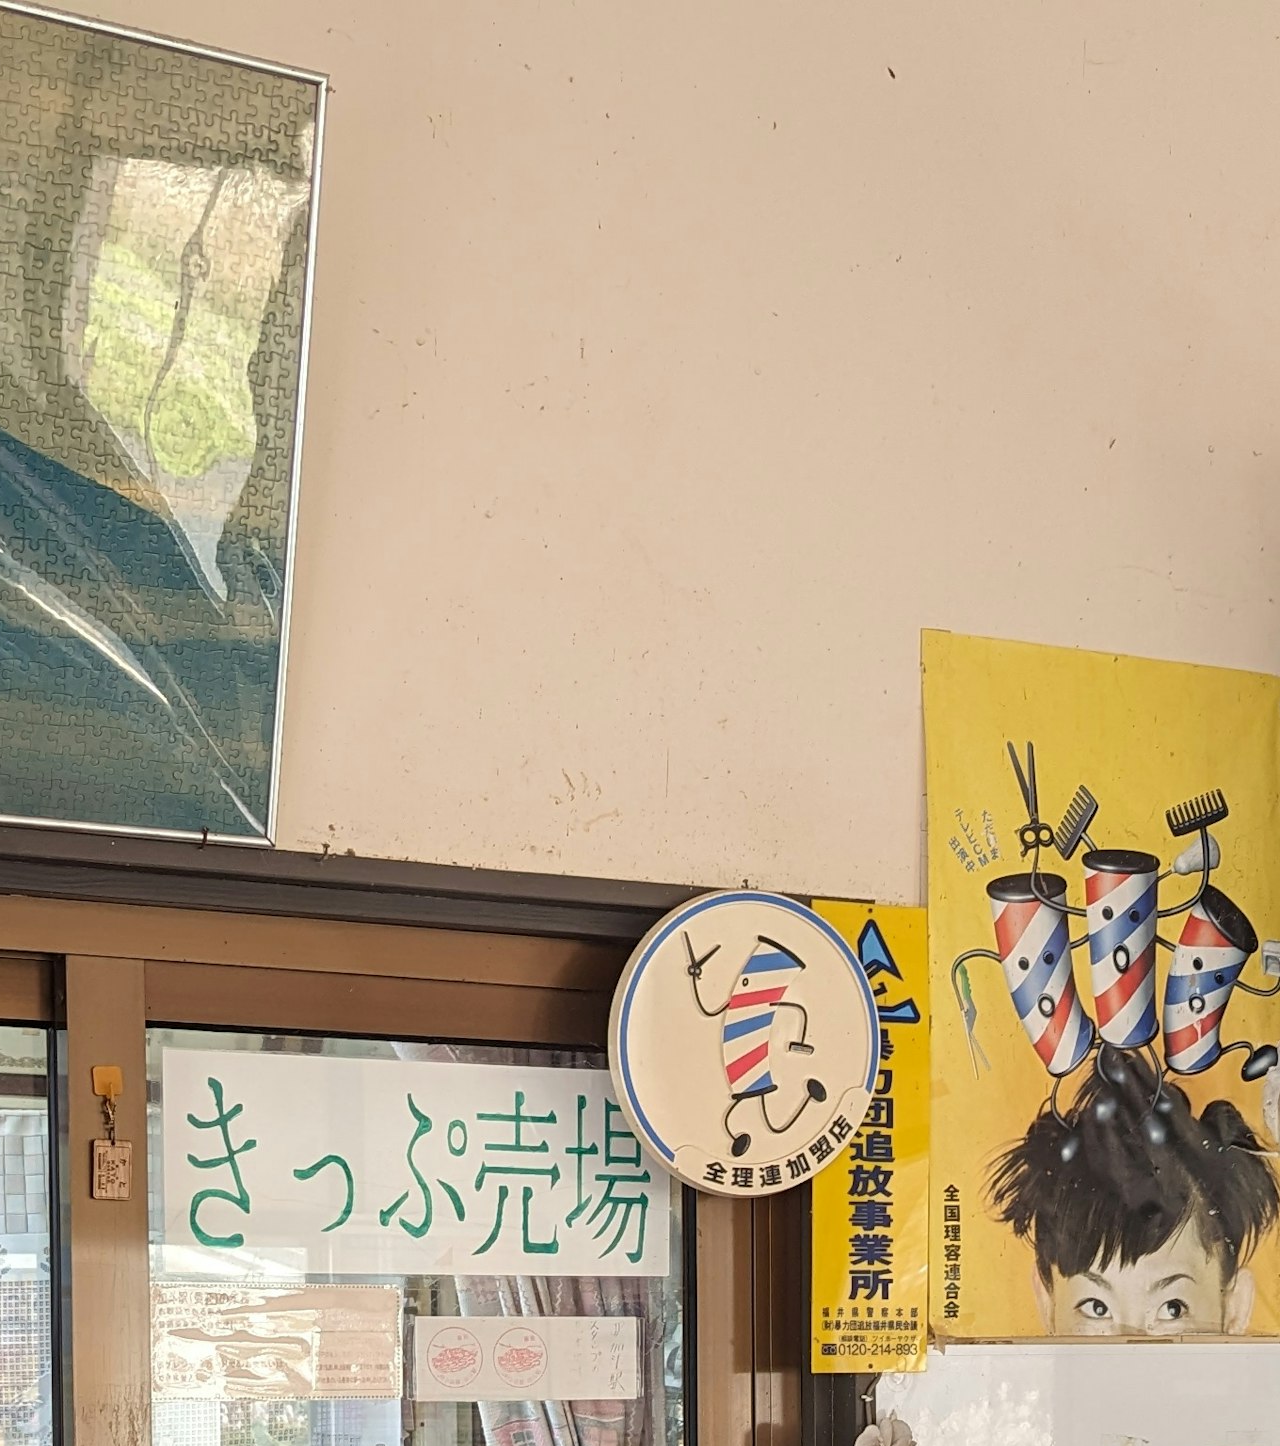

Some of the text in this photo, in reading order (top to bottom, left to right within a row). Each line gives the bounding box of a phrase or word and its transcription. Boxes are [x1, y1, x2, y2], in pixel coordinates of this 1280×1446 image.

[186, 1076, 651, 1264] きっぷ売場
[702, 1113, 853, 1189] 全理連加盟店
[942, 1183, 962, 1320] 全国理容連合会
[838, 1343, 918, 1356] 0120-214-893
